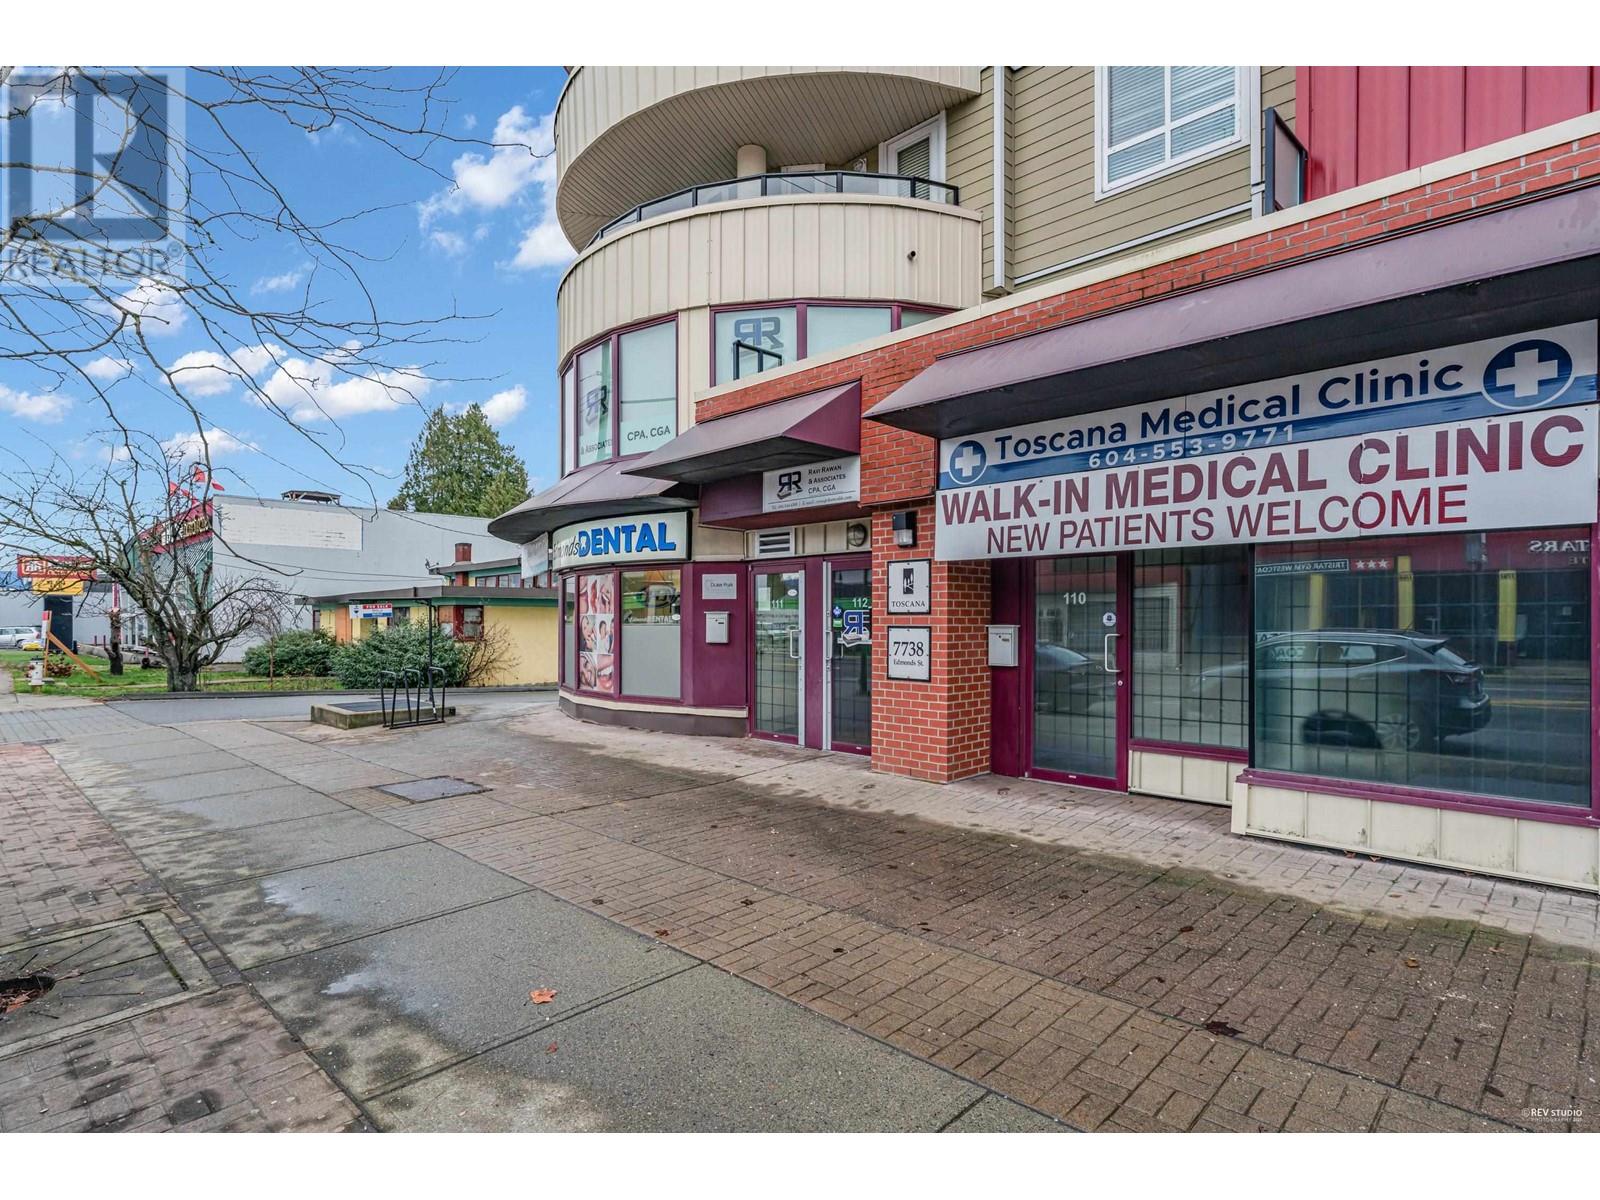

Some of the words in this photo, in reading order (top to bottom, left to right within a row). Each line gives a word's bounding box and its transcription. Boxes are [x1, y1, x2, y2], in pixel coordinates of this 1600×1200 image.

[995, 420, 1127, 459] Toscana
[1141, 384, 1300, 440] Medical
[1319, 359, 1463, 410] Clinic
[650, 425, 671, 437] CGA
[1089, 424, 1294, 468] 604-553-9771
[941, 475, 1089, 526] WALK-IN
[1105, 452, 1327, 510] MEDICAL
[1348, 414, 1585, 485] CLINIC
[813, 474, 846, 484] ASSOCIATES
[822, 484, 836, 492] CGA
[987, 522, 1050, 555] NEW
[1059, 507, 1214, 550] PATIENTS
[1226, 484, 1468, 538] WELCOME
[578, 522, 677, 557] DENTAL
[772, 600, 784, 608] 111
[852, 598, 868, 608] 112
[1063, 592, 1087, 605] 110
[893, 642, 924, 657] 7738
